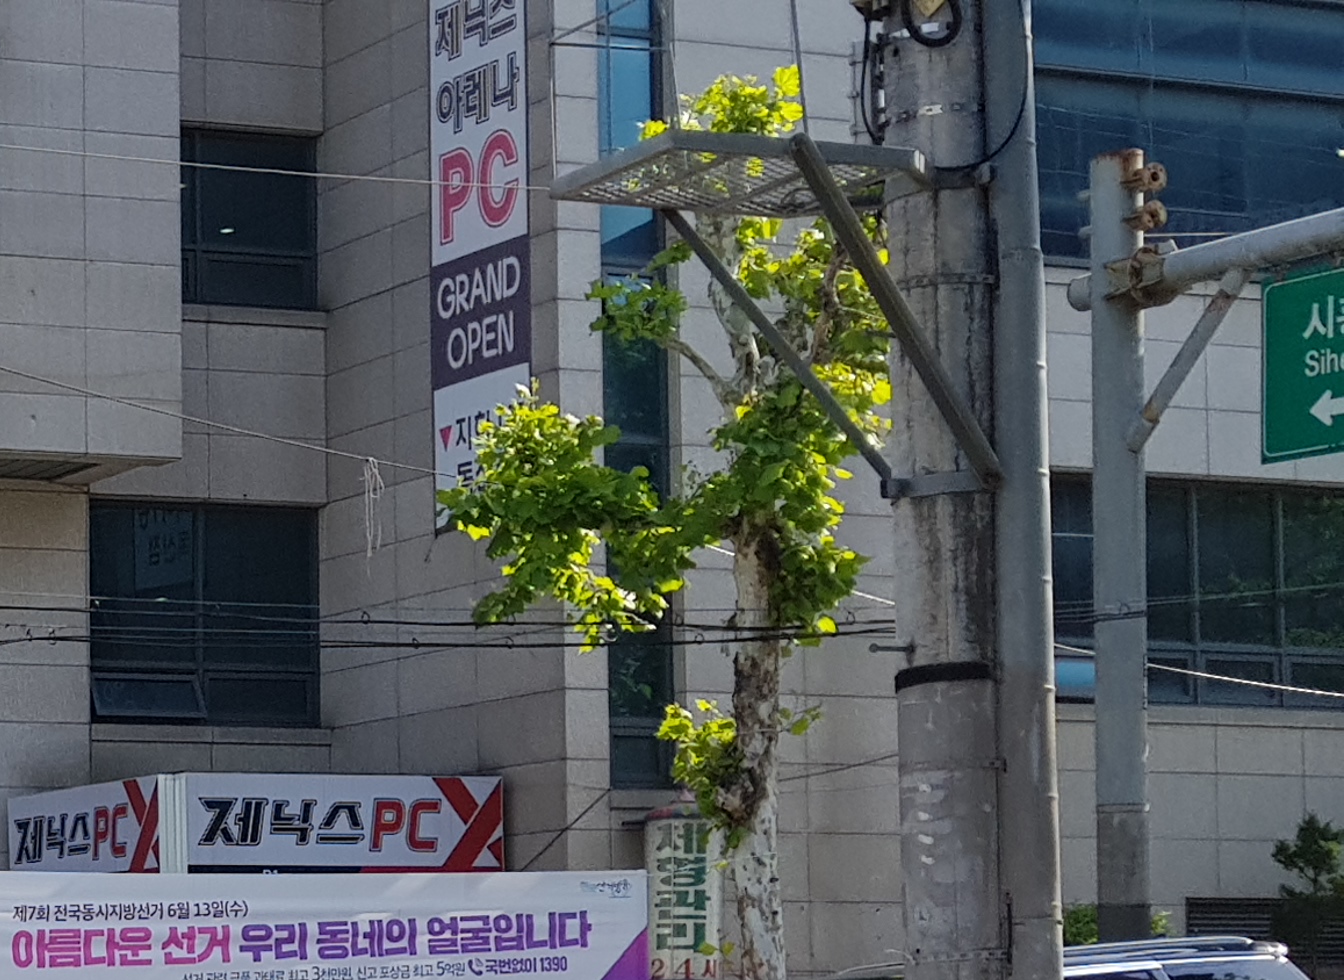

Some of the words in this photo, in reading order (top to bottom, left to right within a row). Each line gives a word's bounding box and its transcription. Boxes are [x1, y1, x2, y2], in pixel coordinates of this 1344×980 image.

[436, 52, 519, 134] 아레나
[438, 129, 519, 246] PC
[437, 256, 520, 320] GRAND
[446, 311, 514, 370] OPEN
[12, 903, 50, 923] 제7회
[53, 901, 164, 923] 전국동시지방선거
[167, 901, 191, 920] 6월
[193, 900, 249, 919] 13일(수)
[12, 925, 153, 969] 아름다운
[160, 923, 231, 965] 선거
[238, 920, 308, 962] 우리
[315, 918, 418, 959] 동네의
[426, 910, 593, 955] 얼굴입니다
[356, 966, 378, 980] 신고
[379, 964, 411, 980] 포상금
[436, 961, 466, 977] 5억원
[485, 957, 538, 976] 국번없이
[540, 956, 568, 973] 1390
